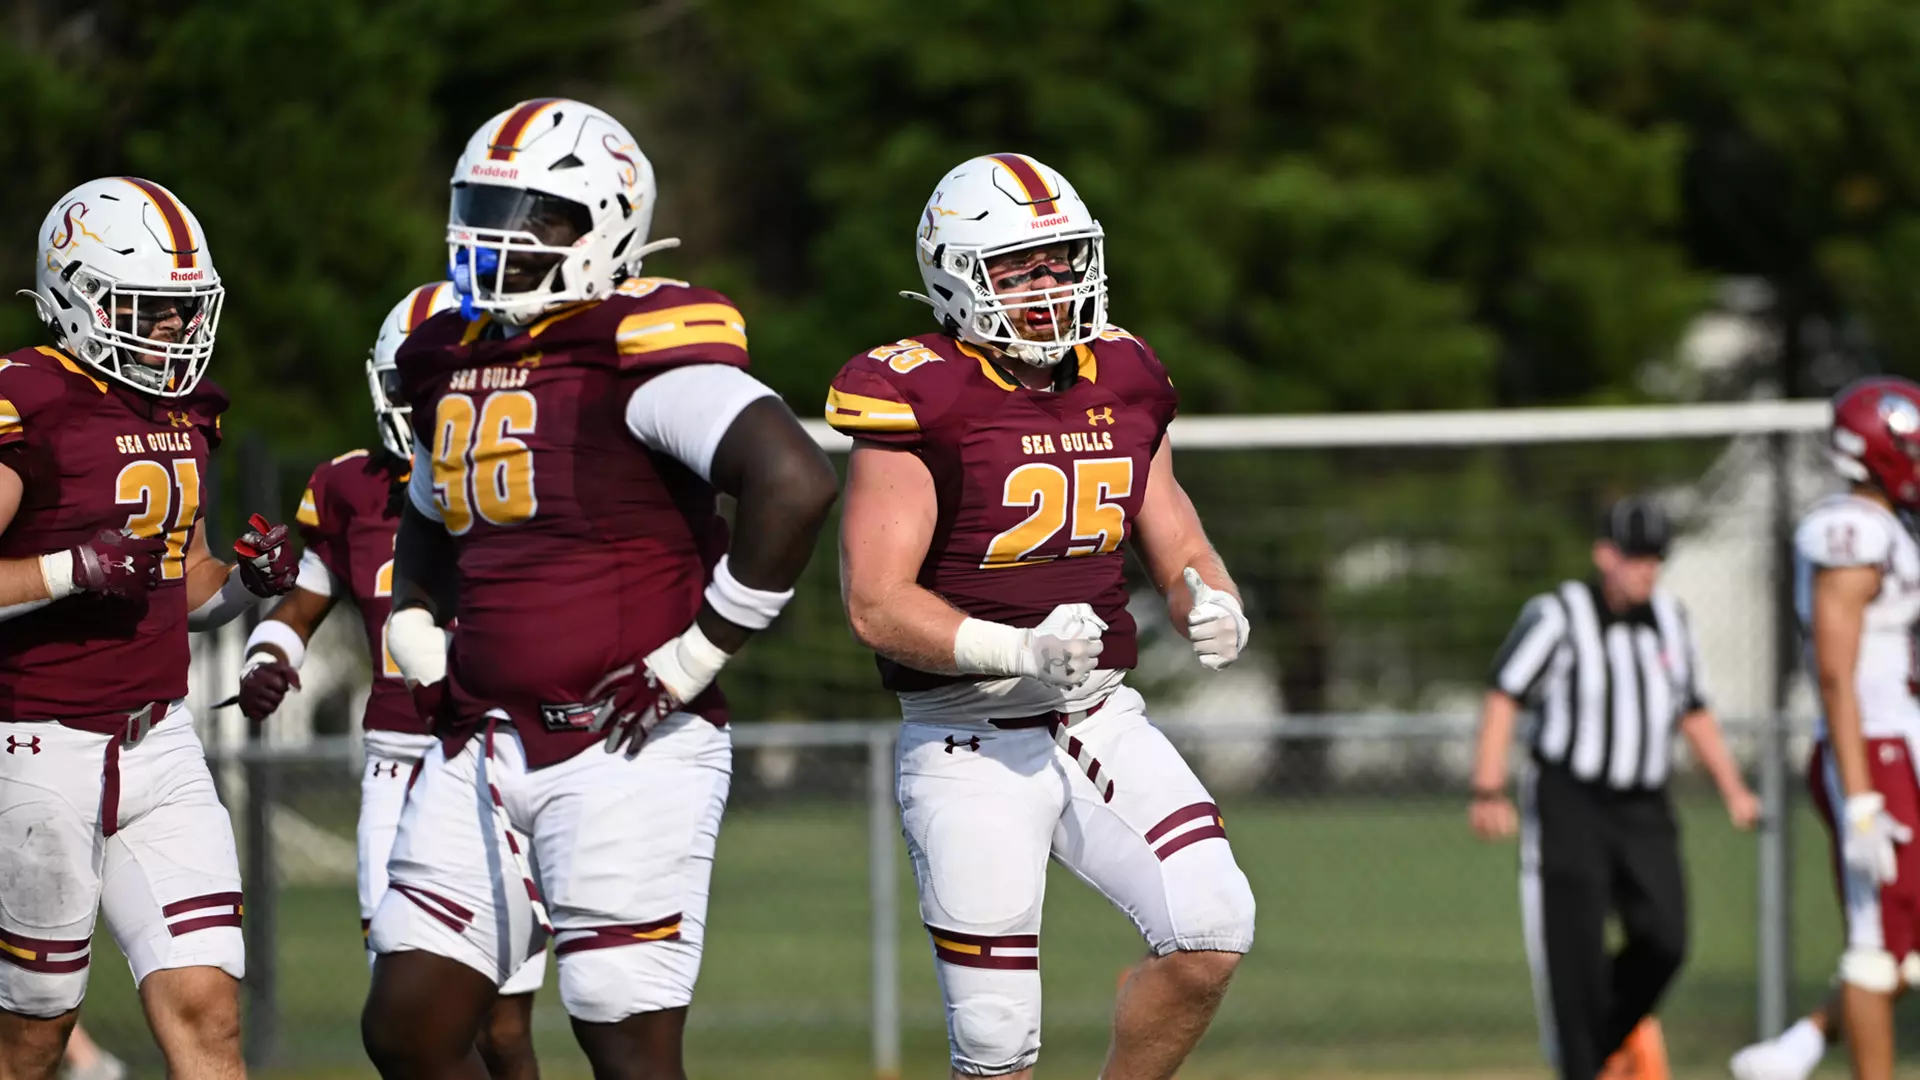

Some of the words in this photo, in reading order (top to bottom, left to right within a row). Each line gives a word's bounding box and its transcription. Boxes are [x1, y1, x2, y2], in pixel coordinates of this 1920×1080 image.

[471, 164, 518, 180] Riddell
[1031, 215, 1069, 229] Riddell
[170, 270, 204, 281] Riddell
[450, 368, 477, 390] SEA
[482, 367, 530, 389] GULLS
[115, 434, 146, 454] SEA
[147, 432, 192, 452] GULLS
[1021, 434, 1056, 455] SEA
[1060, 431, 1114, 452] GULLS
[432, 390, 538, 536] 96
[115, 458, 200, 580] 31
[979, 456, 1133, 569] 25
